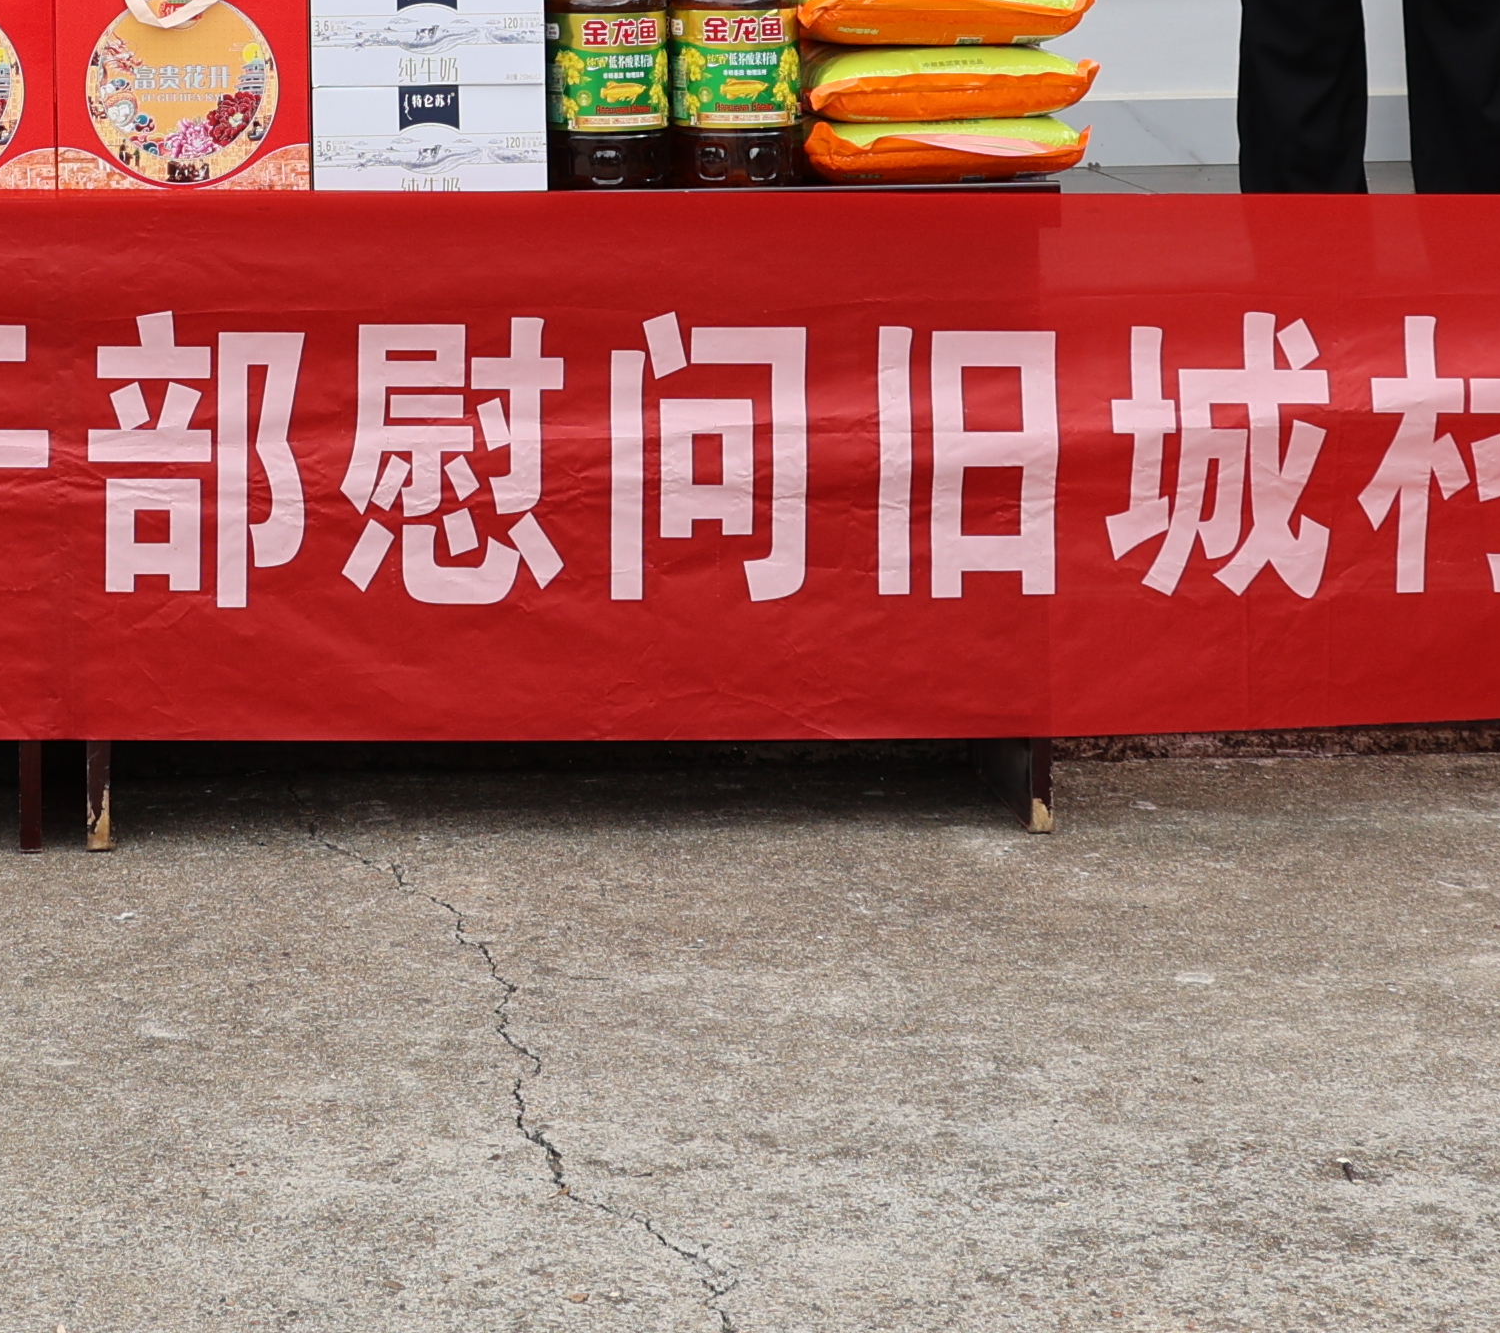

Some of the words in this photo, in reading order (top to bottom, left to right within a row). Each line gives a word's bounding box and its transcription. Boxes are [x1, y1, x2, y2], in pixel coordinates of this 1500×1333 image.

[503, 17, 518, 30] 120
[582, 19, 659, 46] 金龙鱼
[703, 16, 783, 44] 金龙鱼
[133, 65, 231, 90] 富贵花开
[398, 57, 459, 83] 纯牛奶
[411, 94, 445, 109] 特仑苏
[505, 137, 521, 149] 120
